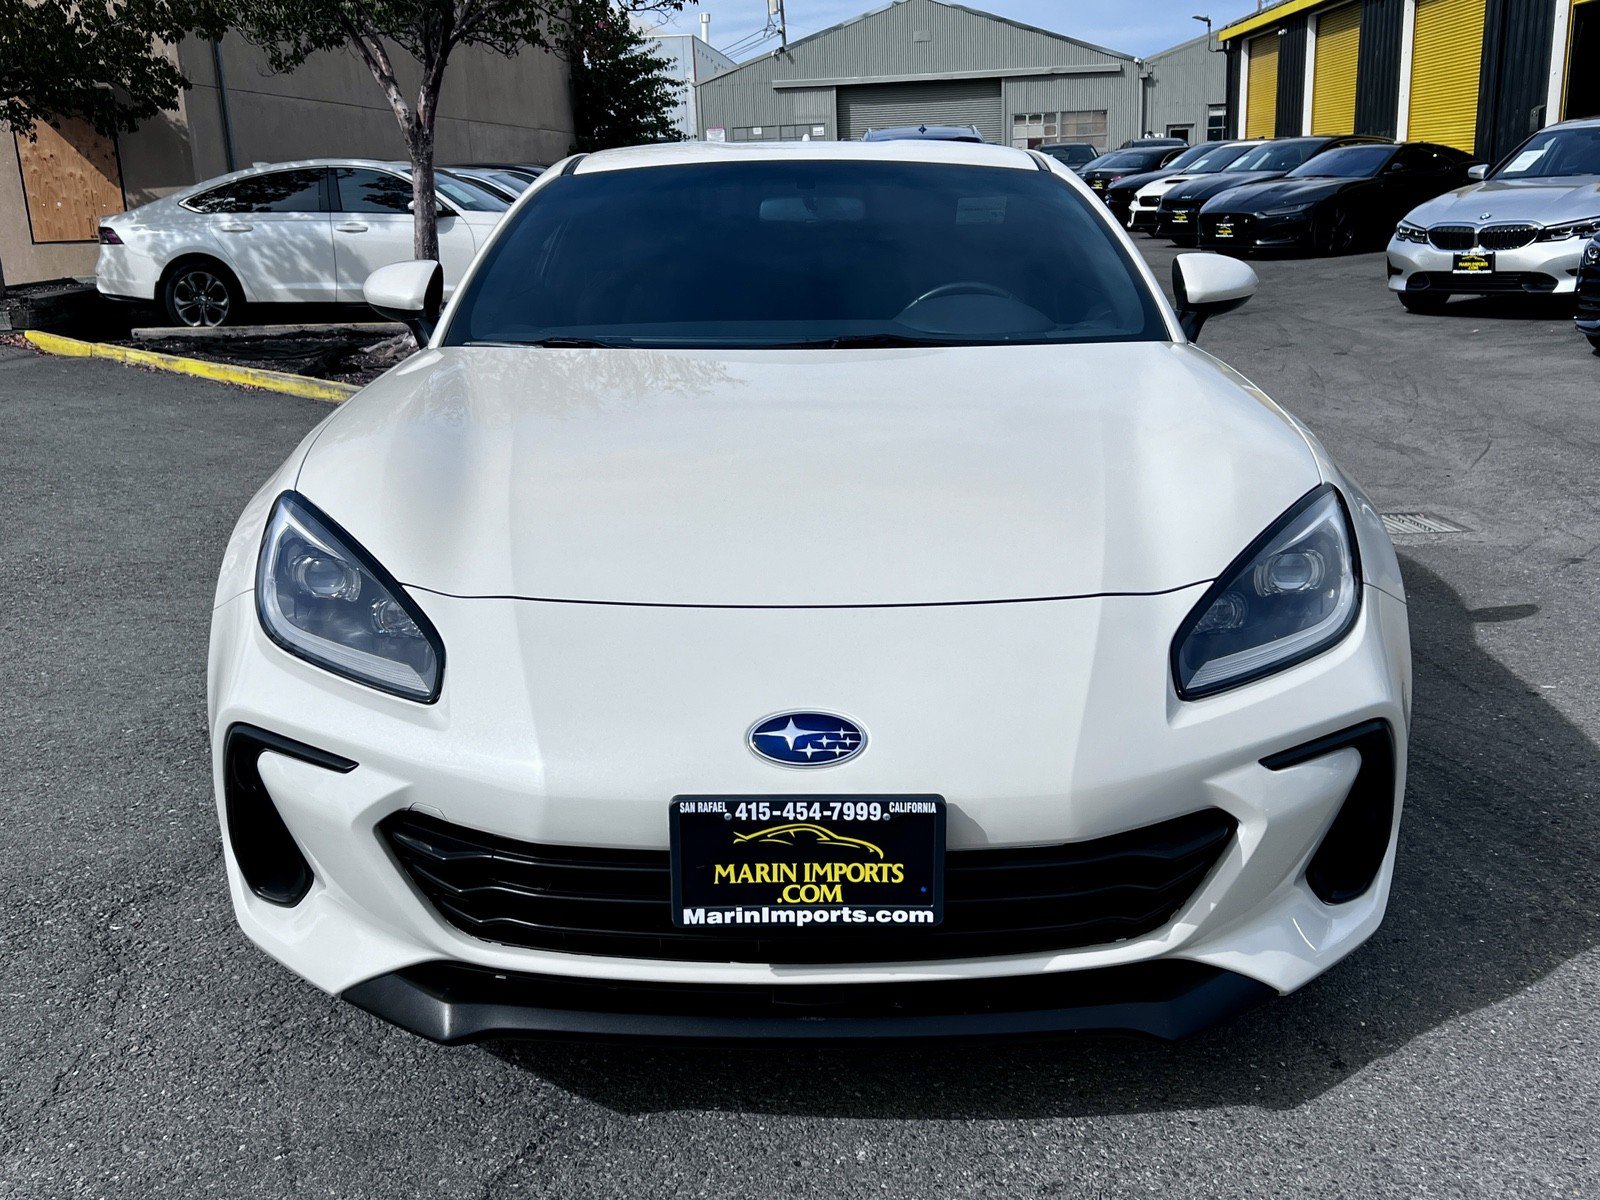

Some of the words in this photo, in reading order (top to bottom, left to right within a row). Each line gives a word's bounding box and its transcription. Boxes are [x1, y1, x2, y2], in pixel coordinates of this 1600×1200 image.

[679, 802, 696, 813] SAN
[697, 802, 728, 813] RAFAEL
[735, 802, 881, 821] 415-454-7999
[888, 802, 937, 813] CALIFORNIA
[714, 863, 797, 884] MARIN
[803, 863, 905, 884] IMPORTS
[776, 884, 843, 903] .COM
[682, 906, 934, 927] MarinImports.com
